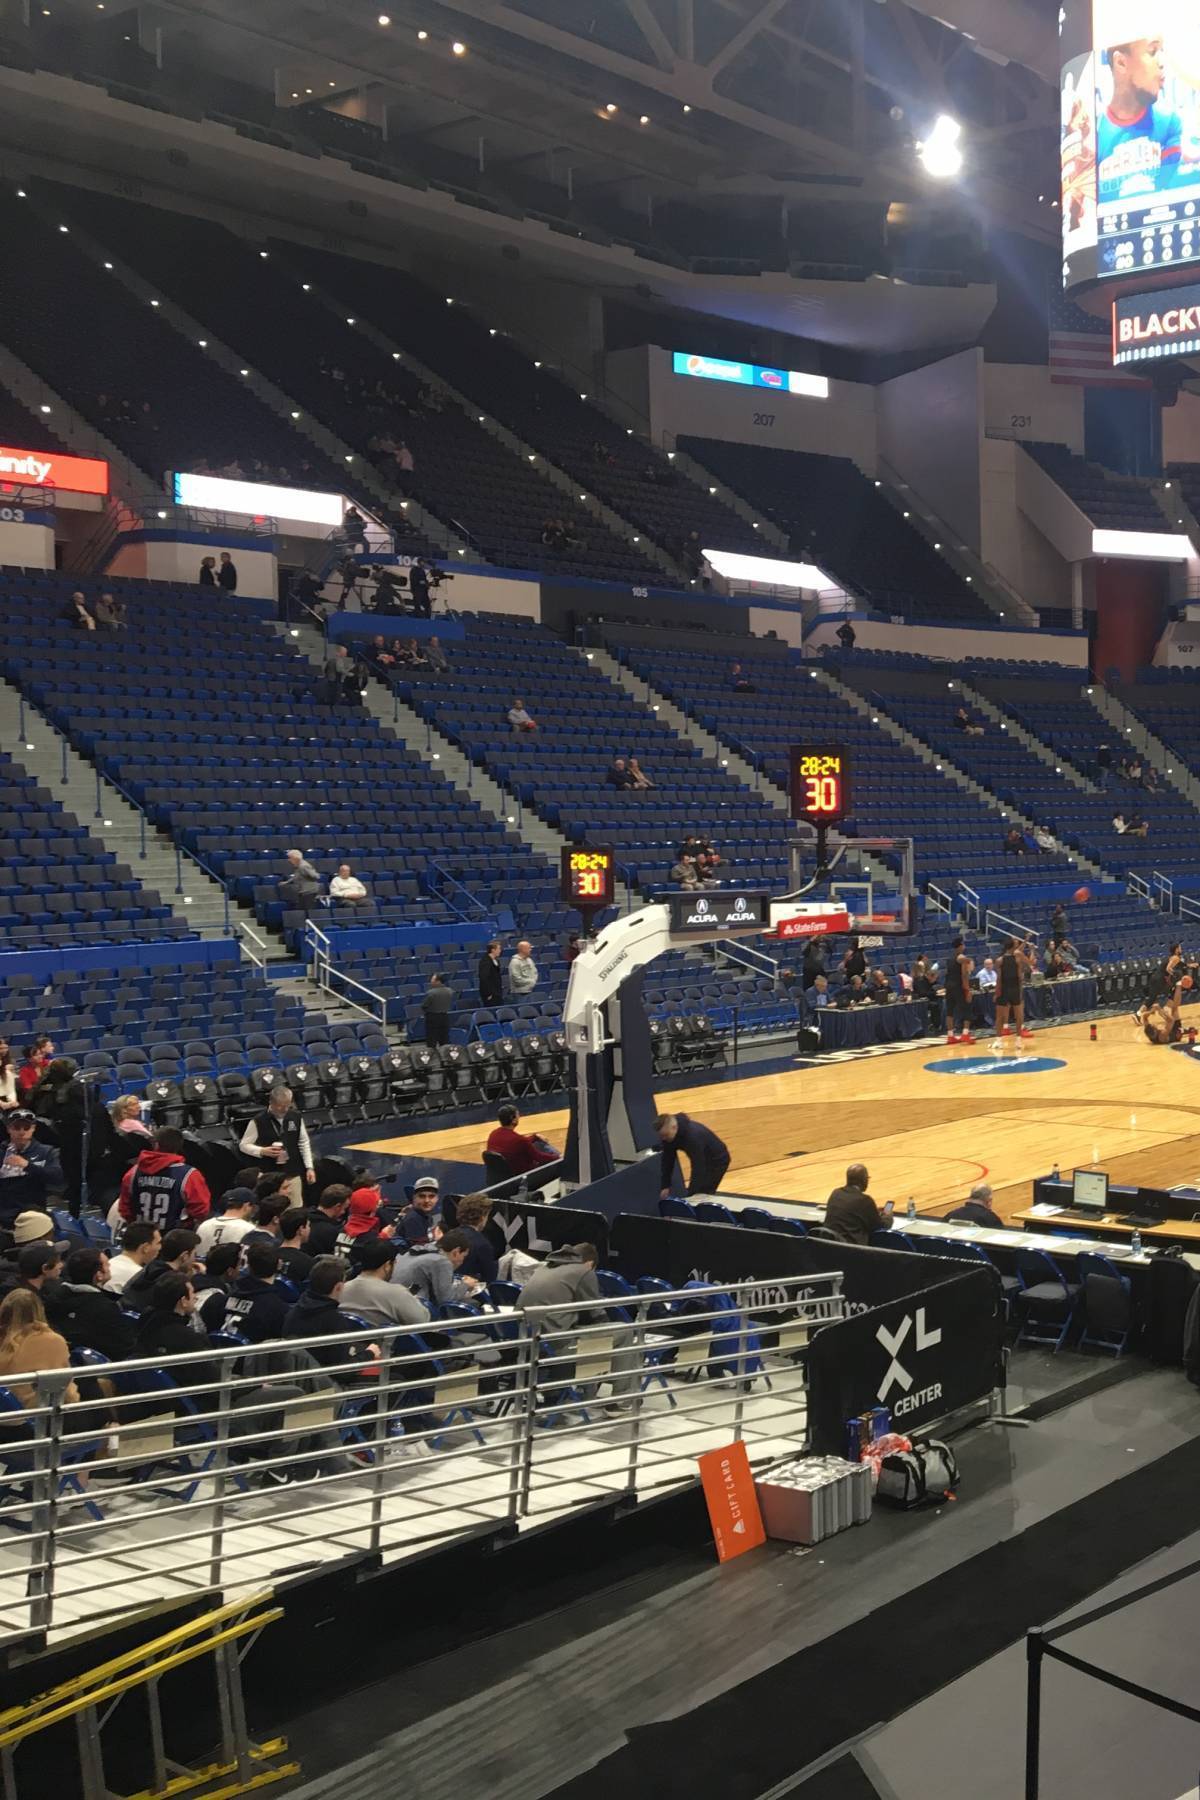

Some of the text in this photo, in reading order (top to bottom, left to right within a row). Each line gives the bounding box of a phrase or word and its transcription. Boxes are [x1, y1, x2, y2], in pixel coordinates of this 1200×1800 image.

[753, 412, 776, 427] 207
[1010, 415, 1032, 428] 231
[632, 587, 648, 598] 105
[800, 756, 840, 775] 28:24
[806, 777, 836, 811] 30
[570, 853, 608, 870] 28:24
[578, 872, 600, 895] 30
[686, 911, 756, 923] ACURA ACURA
[138, 1175, 176, 1190] HAMILTON
[138, 1193, 170, 1230] 32
[876, 1307, 942, 1402] XL
[894, 1383, 942, 1417] CENTER
[720, 1459, 742, 1519] GIFT CARD
